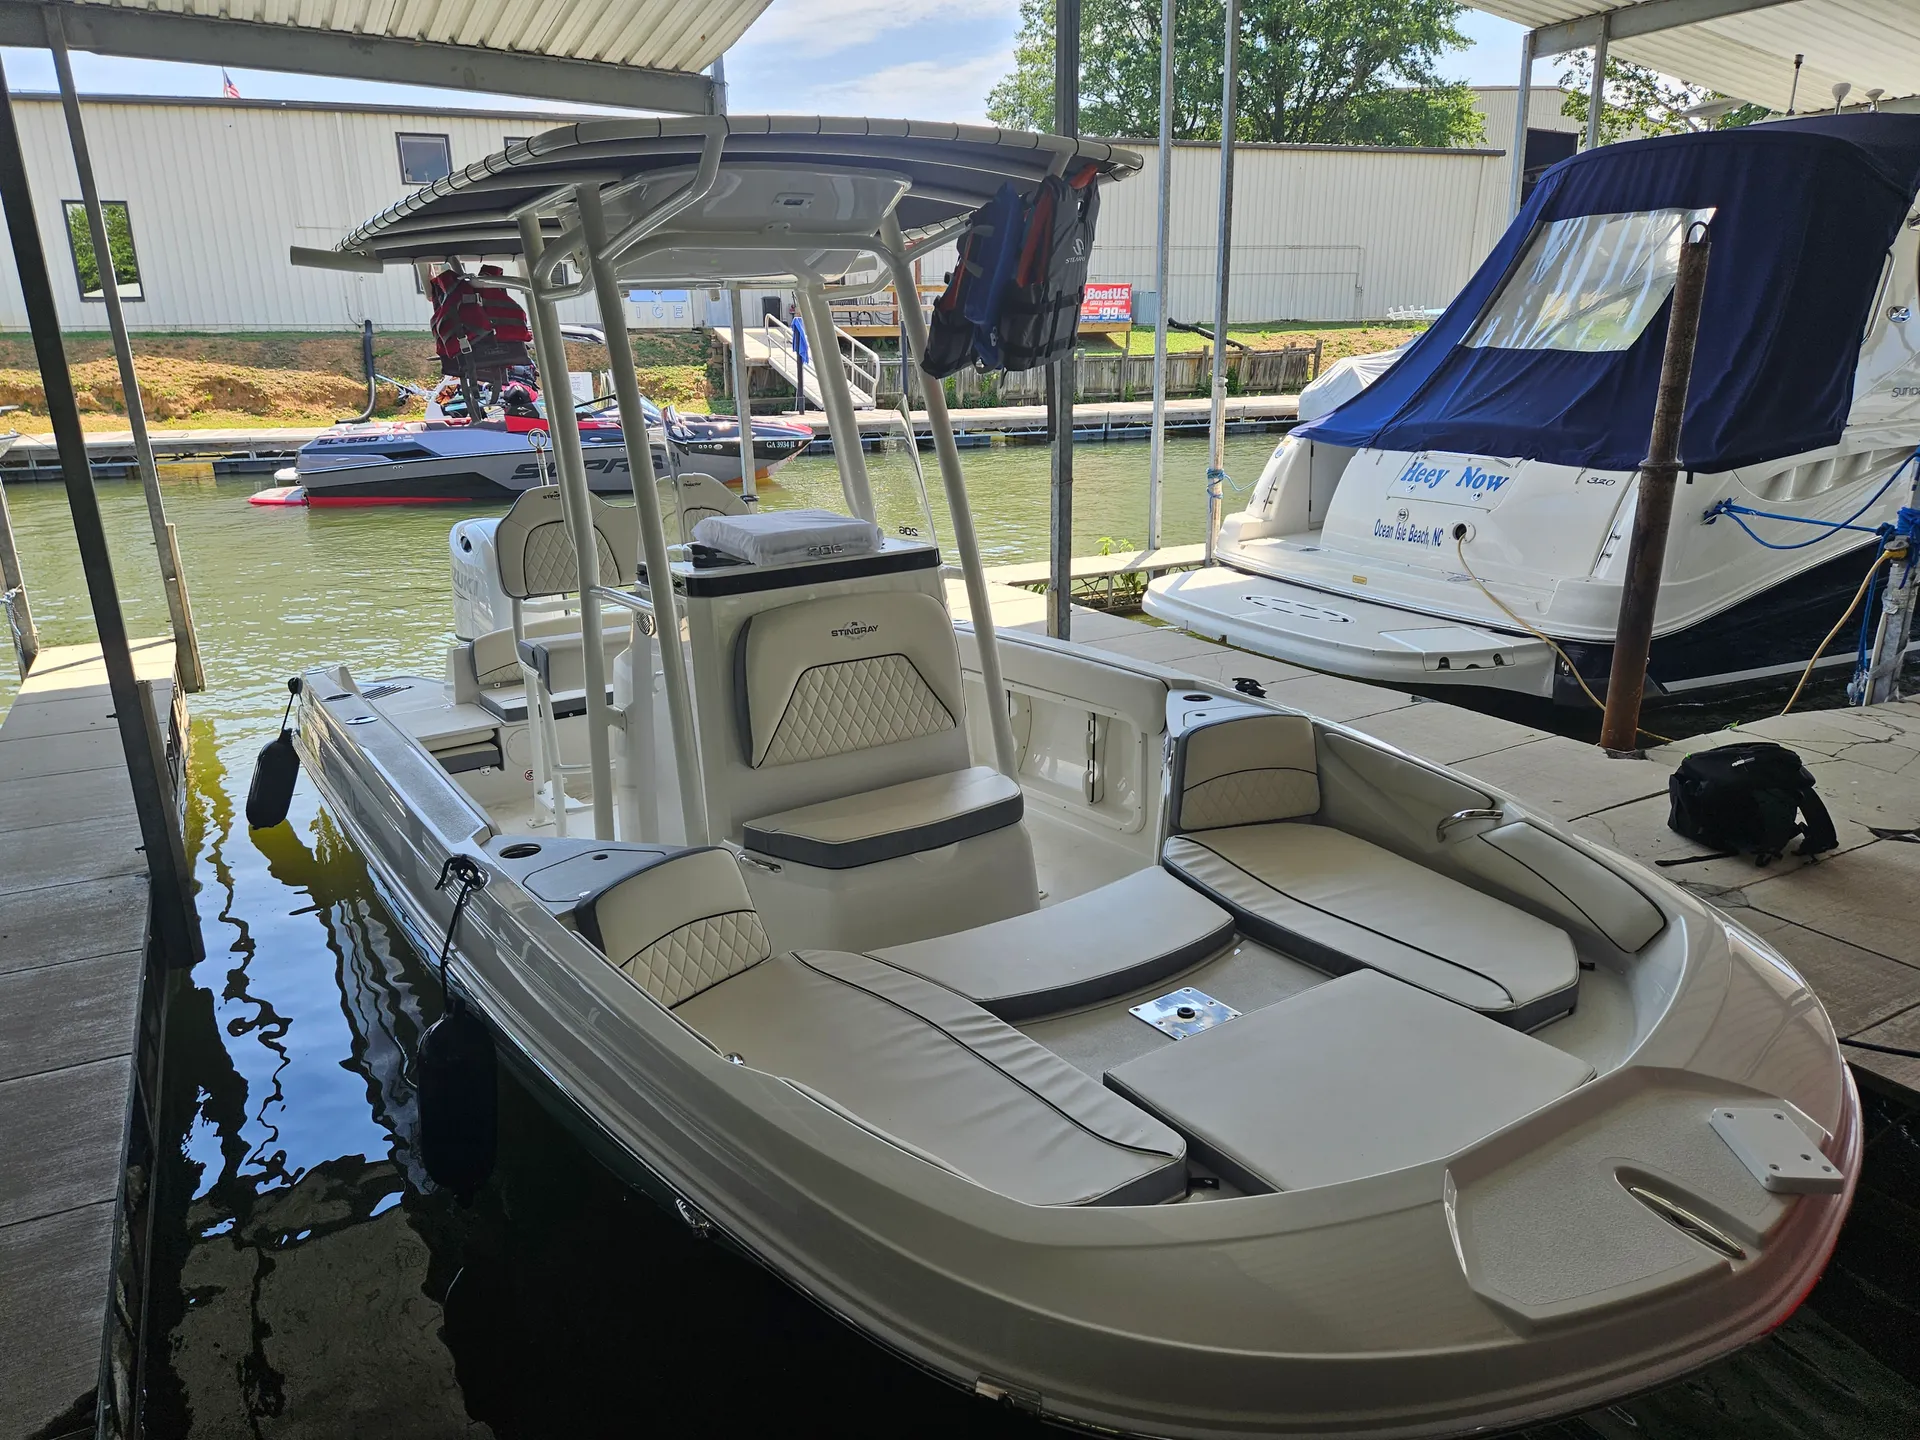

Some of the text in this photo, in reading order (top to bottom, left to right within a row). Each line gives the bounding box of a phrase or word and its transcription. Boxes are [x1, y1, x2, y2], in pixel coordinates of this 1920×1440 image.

[636, 304, 684, 318] ICE
[1401, 461, 1510, 492] Heey Now
[1586, 476, 1616, 486] 320
[1374, 518, 1444, 549] Ocean Isle Beach, NC
[831, 625, 879, 637] STINGRAY
